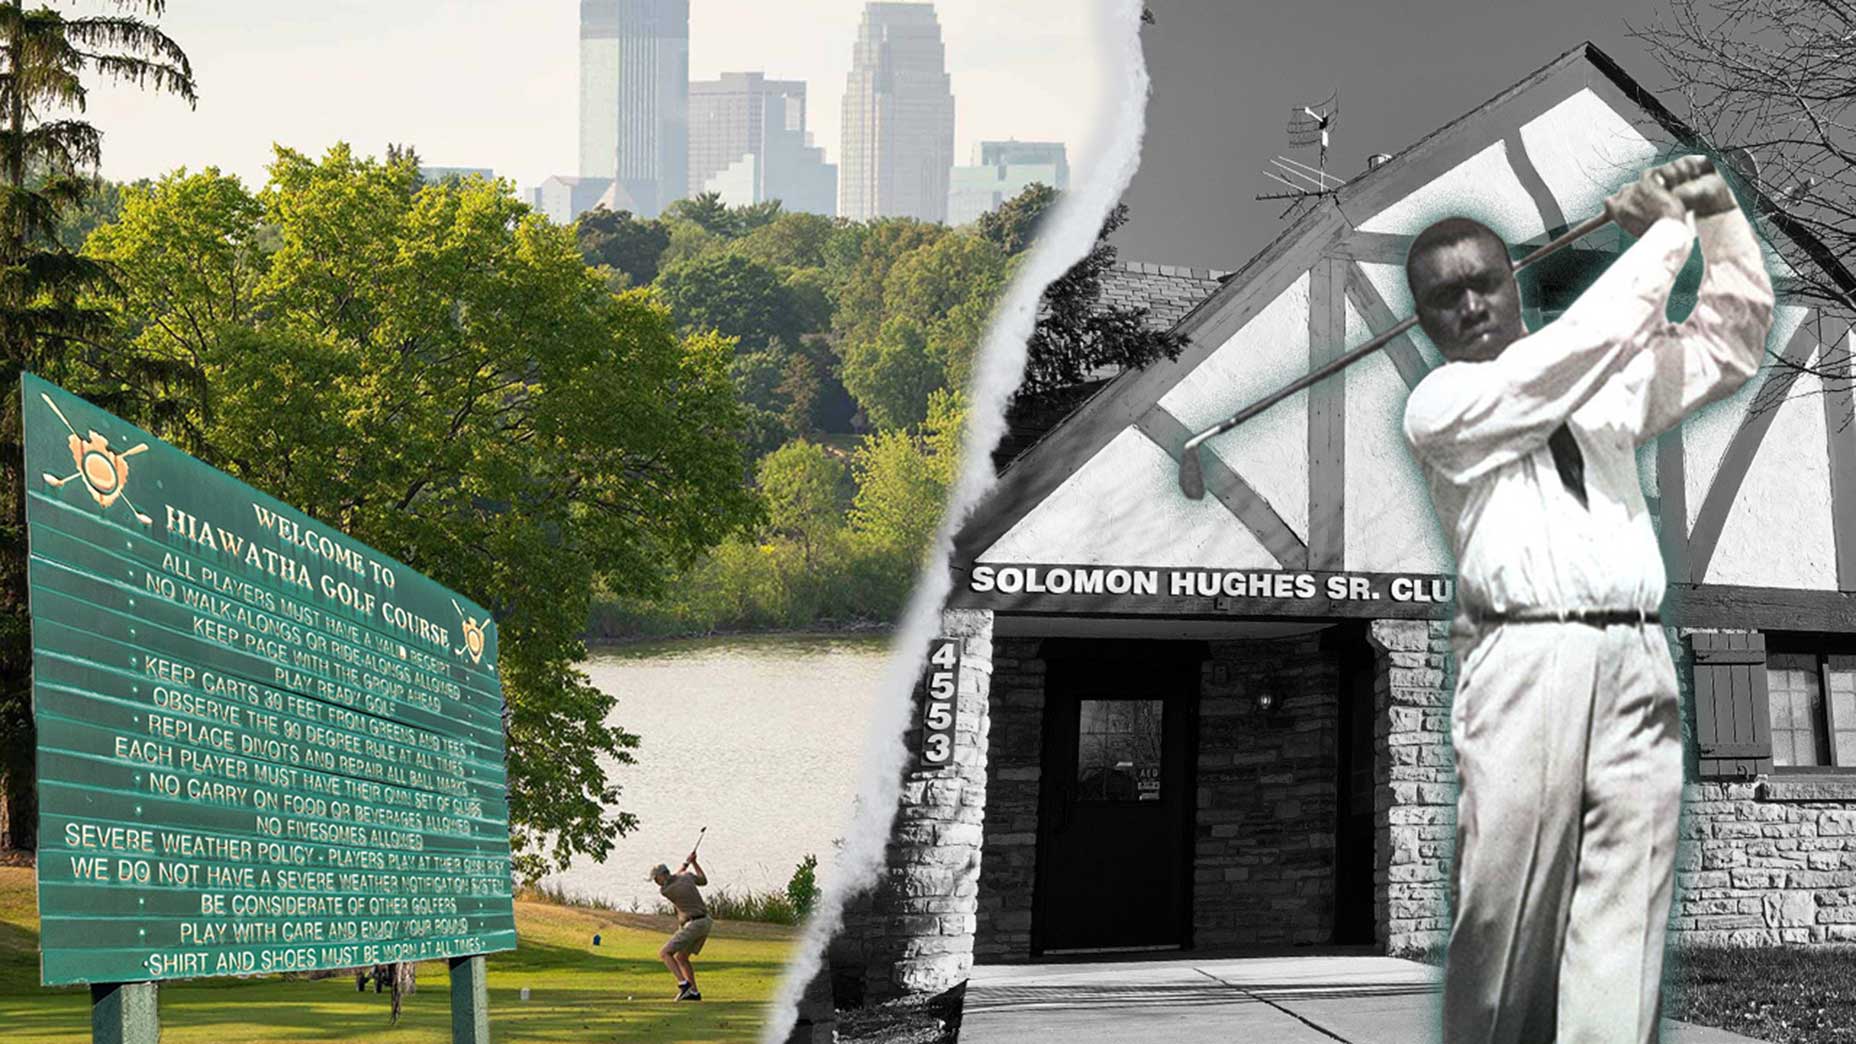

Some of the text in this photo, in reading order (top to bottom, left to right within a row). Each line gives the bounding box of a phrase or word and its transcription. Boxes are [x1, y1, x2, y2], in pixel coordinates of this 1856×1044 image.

[165, 504, 450, 648] HIAWATHA GOLF COURSE
[252, 503, 395, 588] WELCOME TO
[162, 552, 196, 581] ALL
[202, 567, 276, 612] PLAYERS
[280, 598, 320, 626] MUST
[326, 617, 360, 644] HAVE
[364, 632, 373, 648] A
[410, 650, 450, 677] RECEIPT
[971, 566, 1158, 594] SOLOMON
[1170, 572, 1316, 598] HUGHES
[1327, 576, 1380, 600] SR.
[146, 572, 176, 600] NO
[183, 585, 302, 646] WALK-ALONGS
[306, 631, 327, 652] OR
[414, 671, 461, 700] ALLOWED
[193, 616, 441, 712] KEEP PACE WITH THE GROUP AHEAD
[145, 655, 466, 759] KEEP CARTS 30 FEET FROM GREENS AND TEES
[275, 667, 396, 716] PLAY READY GOLF
[149, 714, 468, 796] REPLACE DIVOTS AND REPAIR ALL BALL MARKS
[153, 687, 240, 726] OBSERVE
[247, 710, 278, 735] THE
[306, 725, 362, 754] DEGREE
[365, 739, 395, 762] RULE
[400, 749, 412, 765] AT
[416, 752, 433, 770] ALL
[436, 756, 464, 777] TIMES
[115, 737, 482, 818] EACH PLAYER MUST HAVE THEIR OWN SET OF CLUBS
[150, 773, 471, 834] NO CARRY ON FOOD OR BEVERAGES ALLOWED
[65, 823, 153, 851] SEVERE
[161, 832, 251, 859] WEATHER
[258, 842, 314, 864] POLICY
[329, 848, 385, 870] PLAYERS
[388, 853, 415, 871] PLAY
[418, 856, 431, 870] AT
[256, 816, 424, 851] NO FIVESOMES ALLOWED
[71, 857, 109, 880] WE
[118, 859, 150, 883] DO
[159, 862, 200, 884] NOT
[208, 866, 254, 888] HAVE
[260, 869, 271, 886] A
[277, 870, 334, 890] SEVERE
[339, 874, 398, 893] WEATHER
[201, 894, 457, 915] BE CONSIDERATE OF OTHER GOLFERS
[149, 937, 480, 975] SHIRT AND SHOES MUST BE WORN AT ALL TIMES
[180, 917, 468, 944] PLAY WITH CARE AND ENJOY YOUR ROUND
